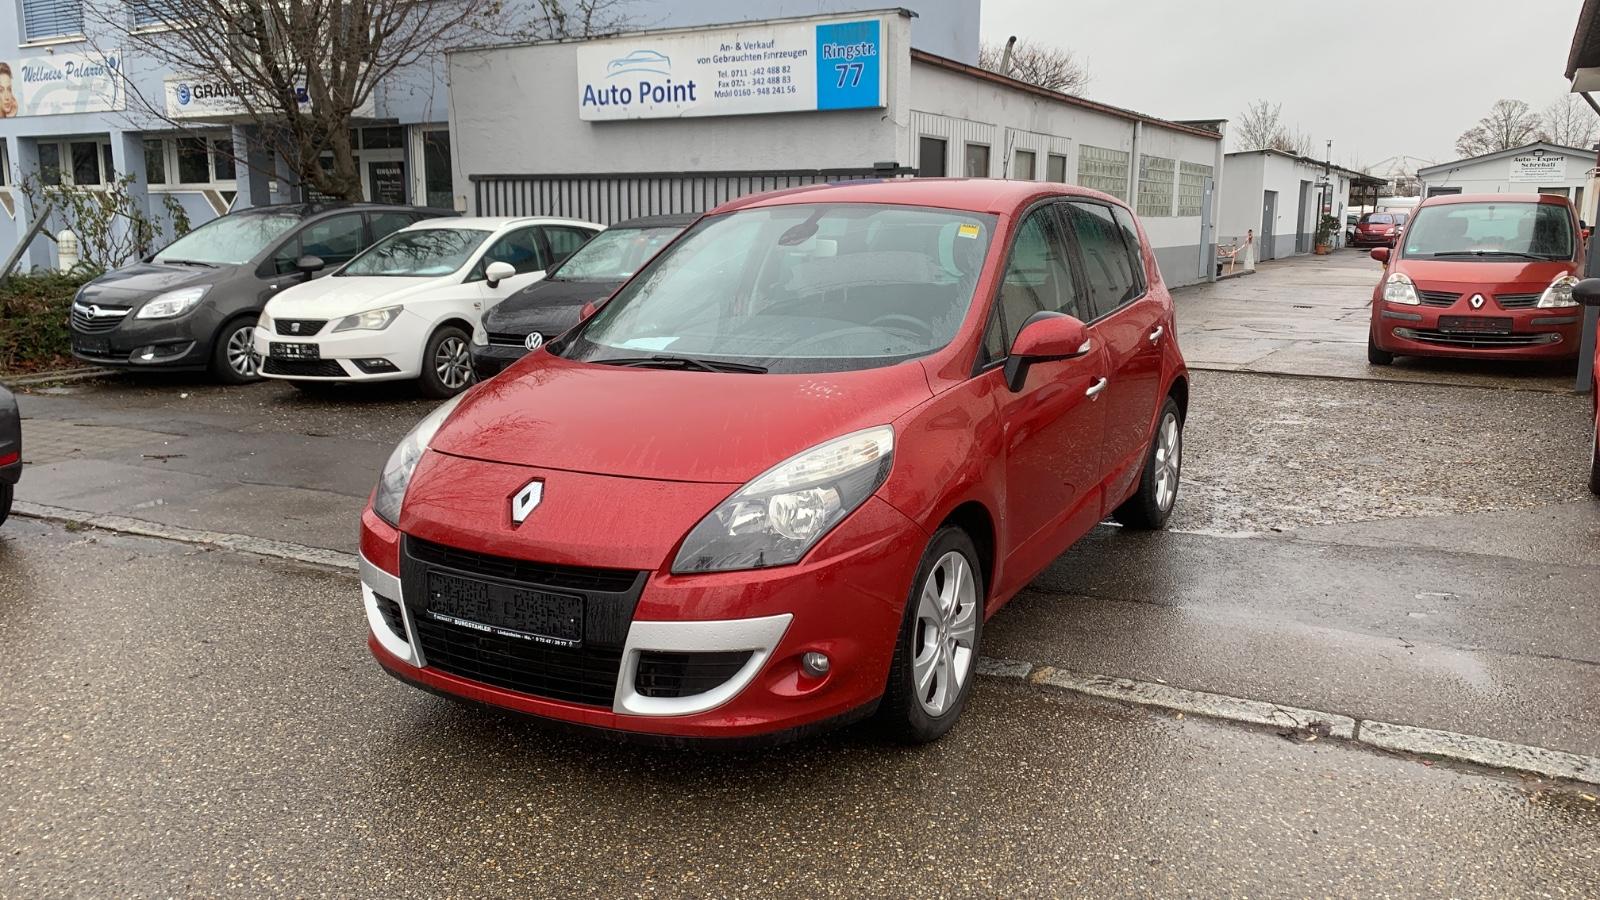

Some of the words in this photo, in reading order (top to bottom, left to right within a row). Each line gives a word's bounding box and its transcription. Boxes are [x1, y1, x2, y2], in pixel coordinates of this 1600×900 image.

[735, 42, 742, 51] &
[743, 39, 775, 51] Verkauf
[823, 42, 877, 60] Ringstr.
[697, 57, 711, 65] von
[713, 53, 762, 64] Gebrauchten
[22, 66, 62, 82] Wellness
[65, 61, 104, 80] Palazzo
[731, 69, 748, 78] 0711
[767, 65, 780, 75] 488
[782, 65, 791, 74] 82
[835, 62, 864, 88] 77
[752, 77, 765, 86] 342
[767, 76, 780, 85] 488
[782, 75, 791, 84] 83
[582, 84, 632, 106] Auto
[640, 78, 697, 104] Point
[733, 88, 751, 97] 0160
[756, 86, 770, 96] 948
[772, 85, 785, 95] 241
[787, 84, 796, 93] 56
